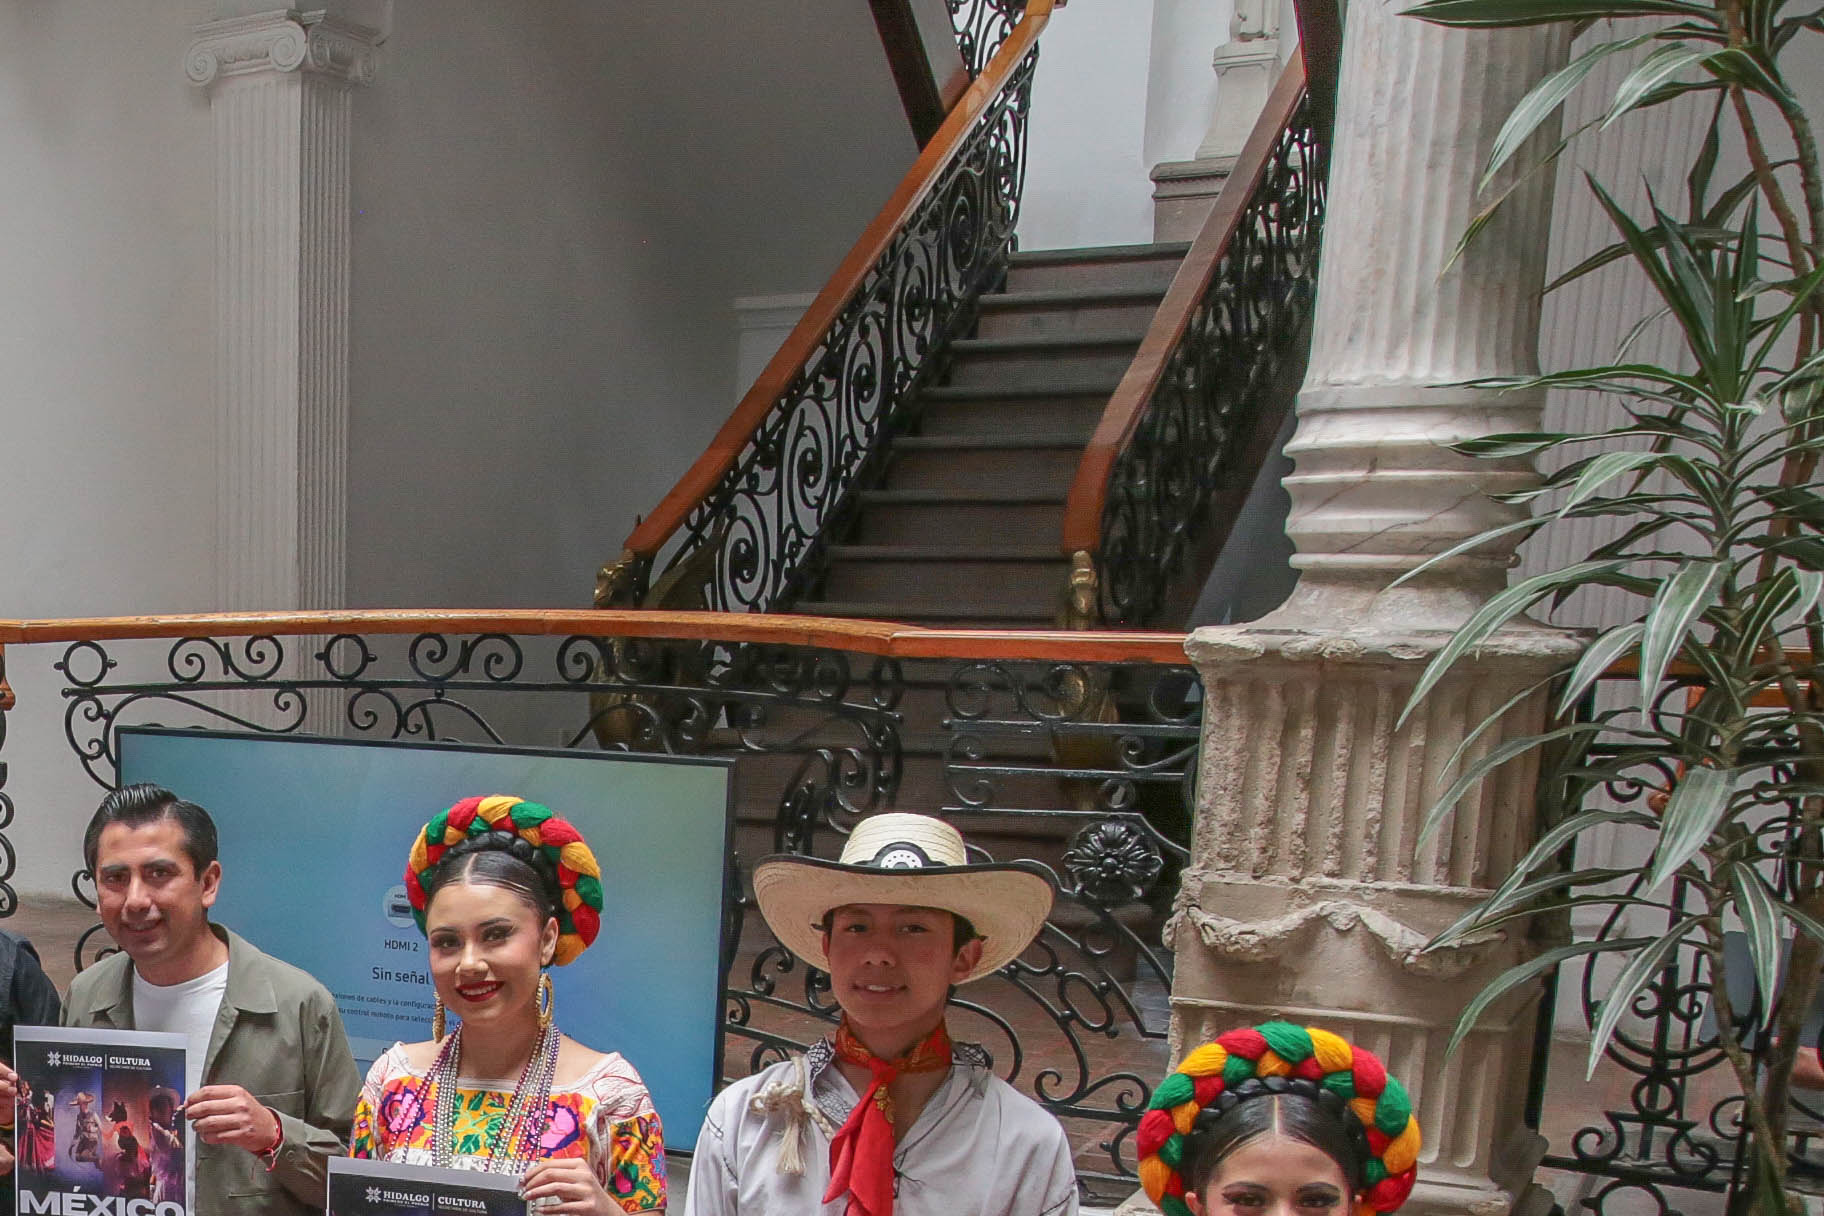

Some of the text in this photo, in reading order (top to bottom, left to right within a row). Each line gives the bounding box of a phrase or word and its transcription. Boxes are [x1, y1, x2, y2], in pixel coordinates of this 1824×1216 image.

[384, 939, 419, 952] HDMI 2
[372, 967, 430, 985] Sin señal
[356, 994, 365, 1002] de
[62, 1054, 103, 1064] HIDALGO
[109, 1056, 151, 1066] CULTURA
[383, 1190, 430, 1203] HIDALGO
[437, 1196, 487, 1210] CULTURA
